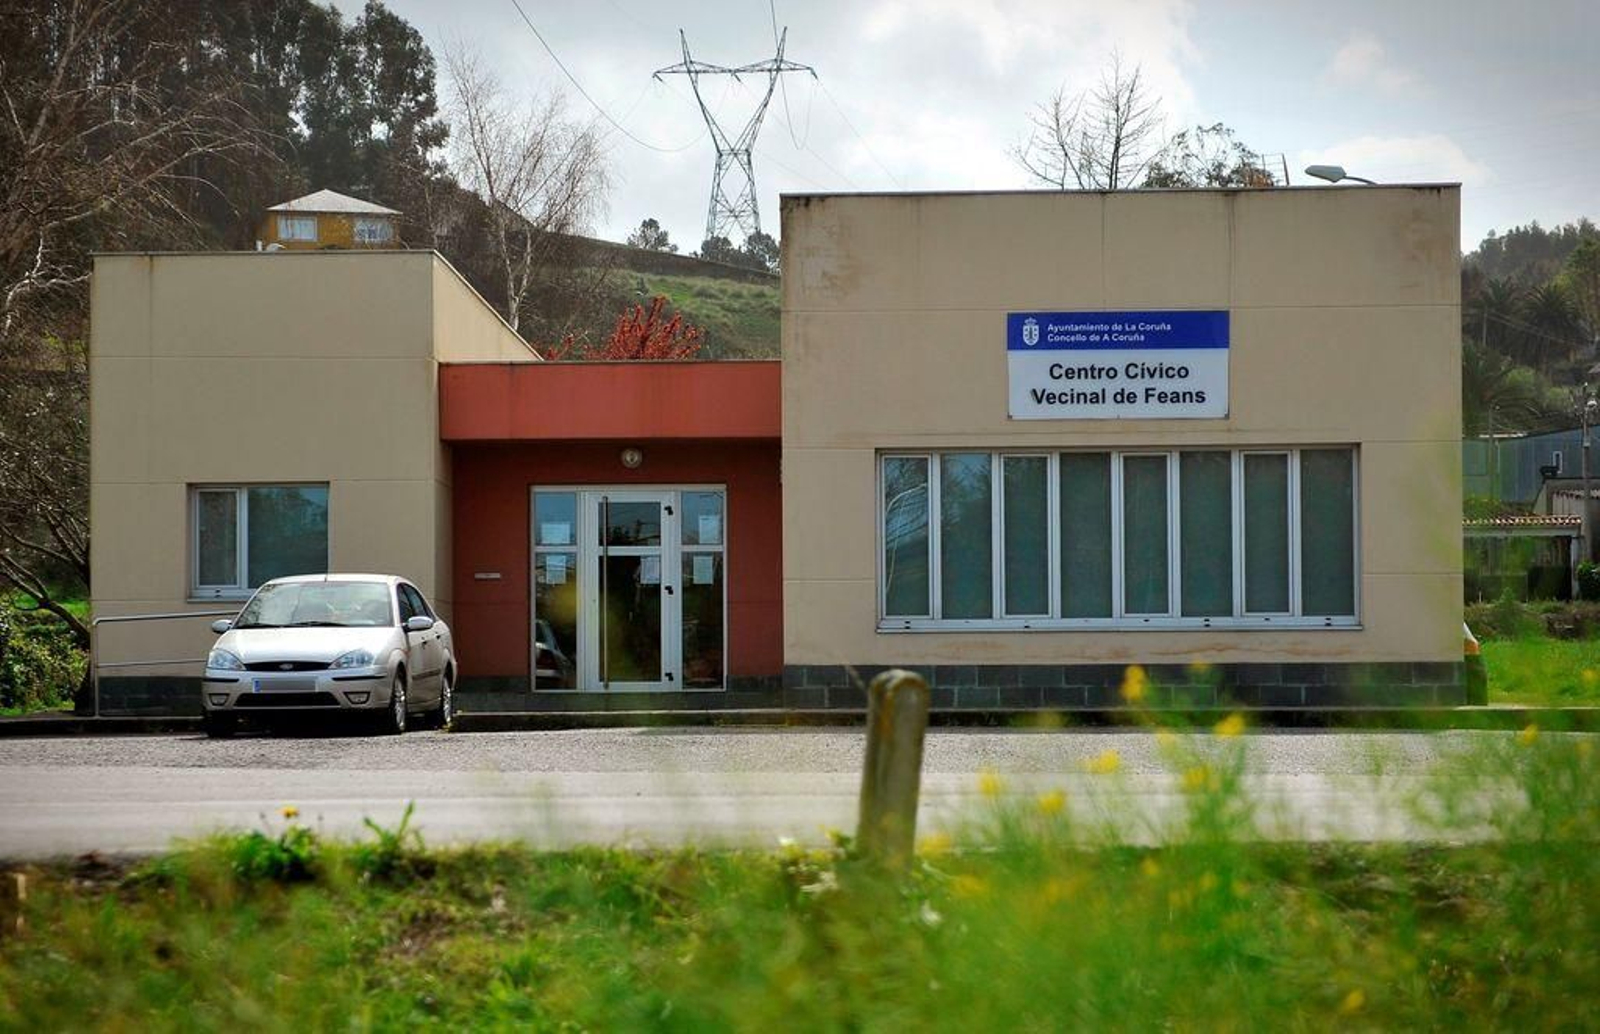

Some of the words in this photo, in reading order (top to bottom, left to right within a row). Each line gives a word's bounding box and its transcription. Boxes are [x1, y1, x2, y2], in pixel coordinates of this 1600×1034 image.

[1047, 323, 1109, 332] Ayuntamiento
[1112, 323, 1122, 331] de
[1125, 323, 1136, 331] La
[1139, 322, 1171, 331] Coruña
[1047, 334, 1087, 342] Concello
[1089, 333, 1100, 341] de
[1103, 333, 1109, 341] A
[1111, 333, 1144, 341] Coruña
[1049, 363, 1118, 380] Centro
[1125, 362, 1189, 379] Cívico
[1031, 388, 1105, 405] Vecinal
[1113, 388, 1137, 403] de
[1144, 388, 1206, 403] Feans
